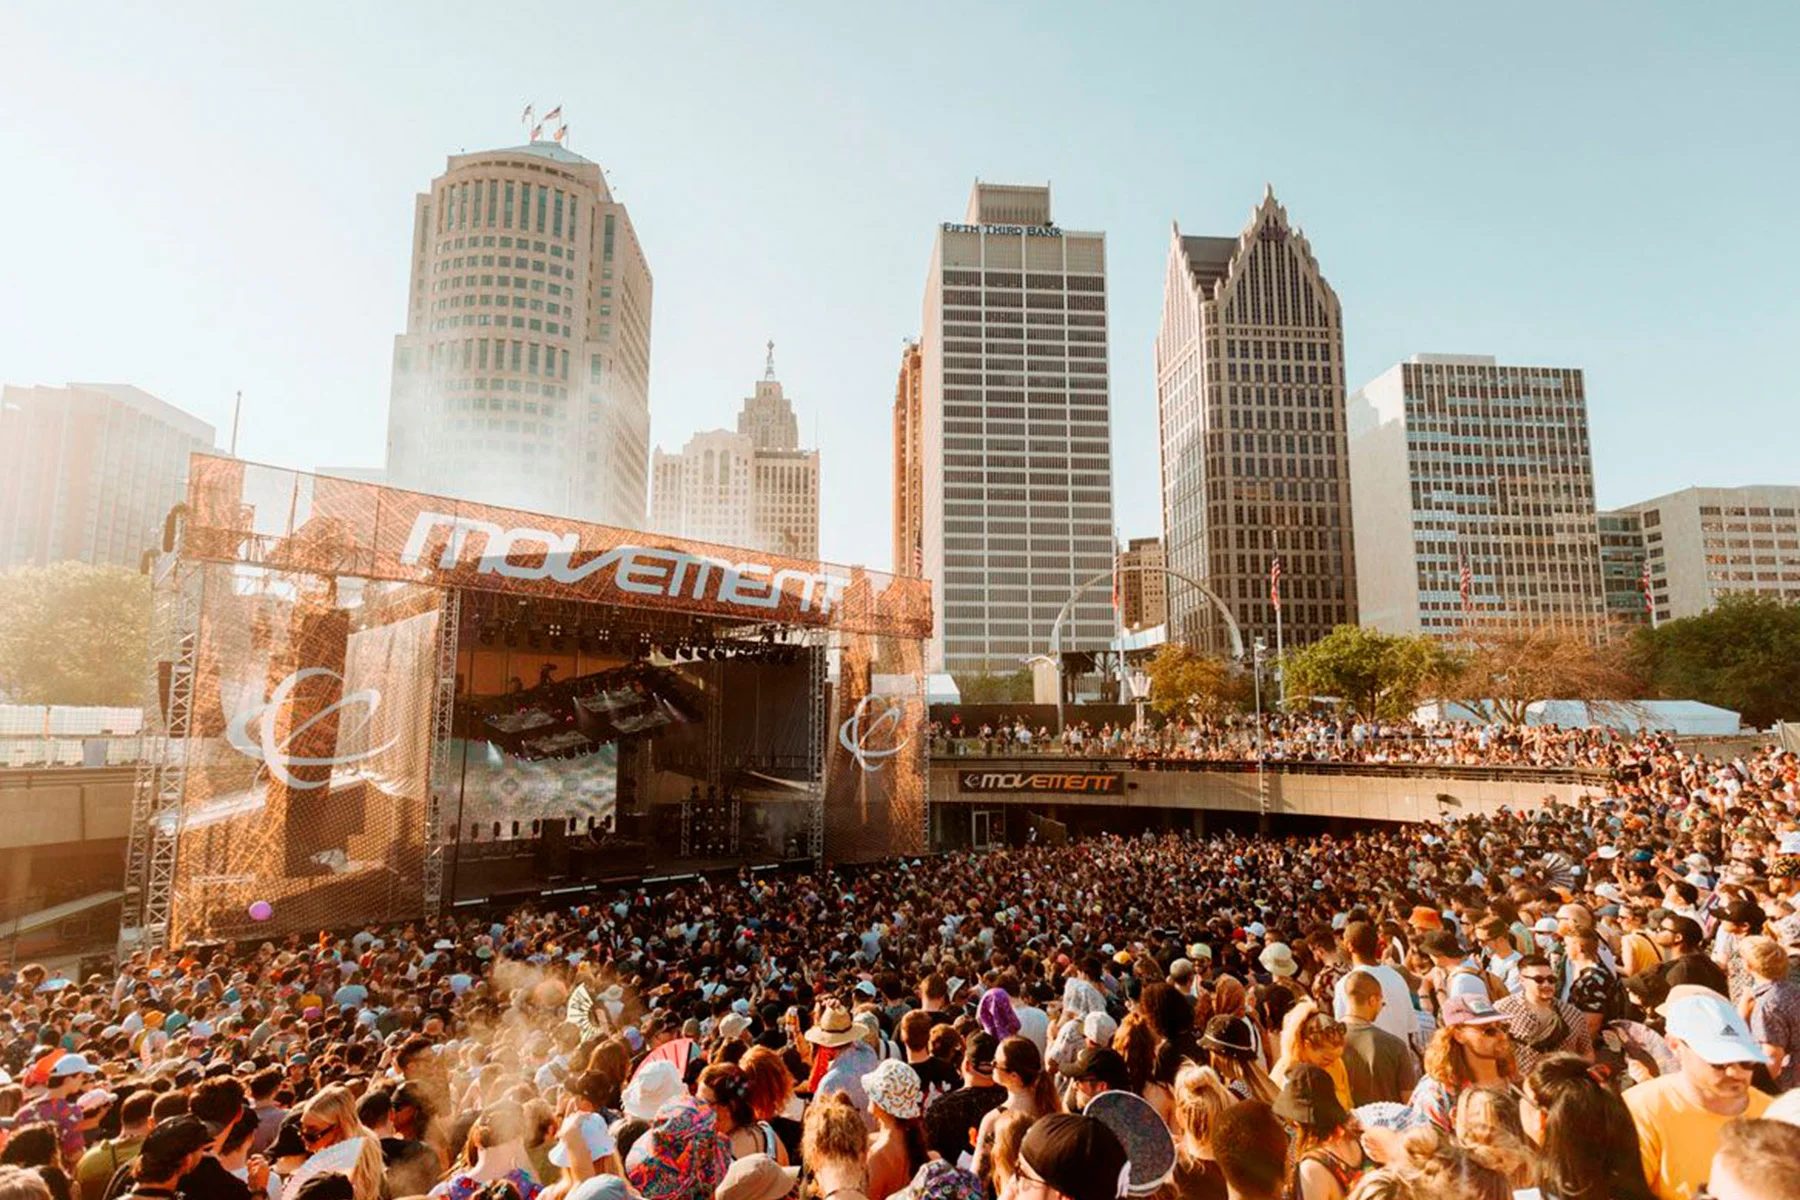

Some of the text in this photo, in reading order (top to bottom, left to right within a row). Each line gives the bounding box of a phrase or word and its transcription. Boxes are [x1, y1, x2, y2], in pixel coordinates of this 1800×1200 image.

[943, 222, 1063, 238] FIFTH THIRD BANK
[401, 511, 849, 614] MOVEMENT
[981, 773, 1118, 790] MOVEMENT
